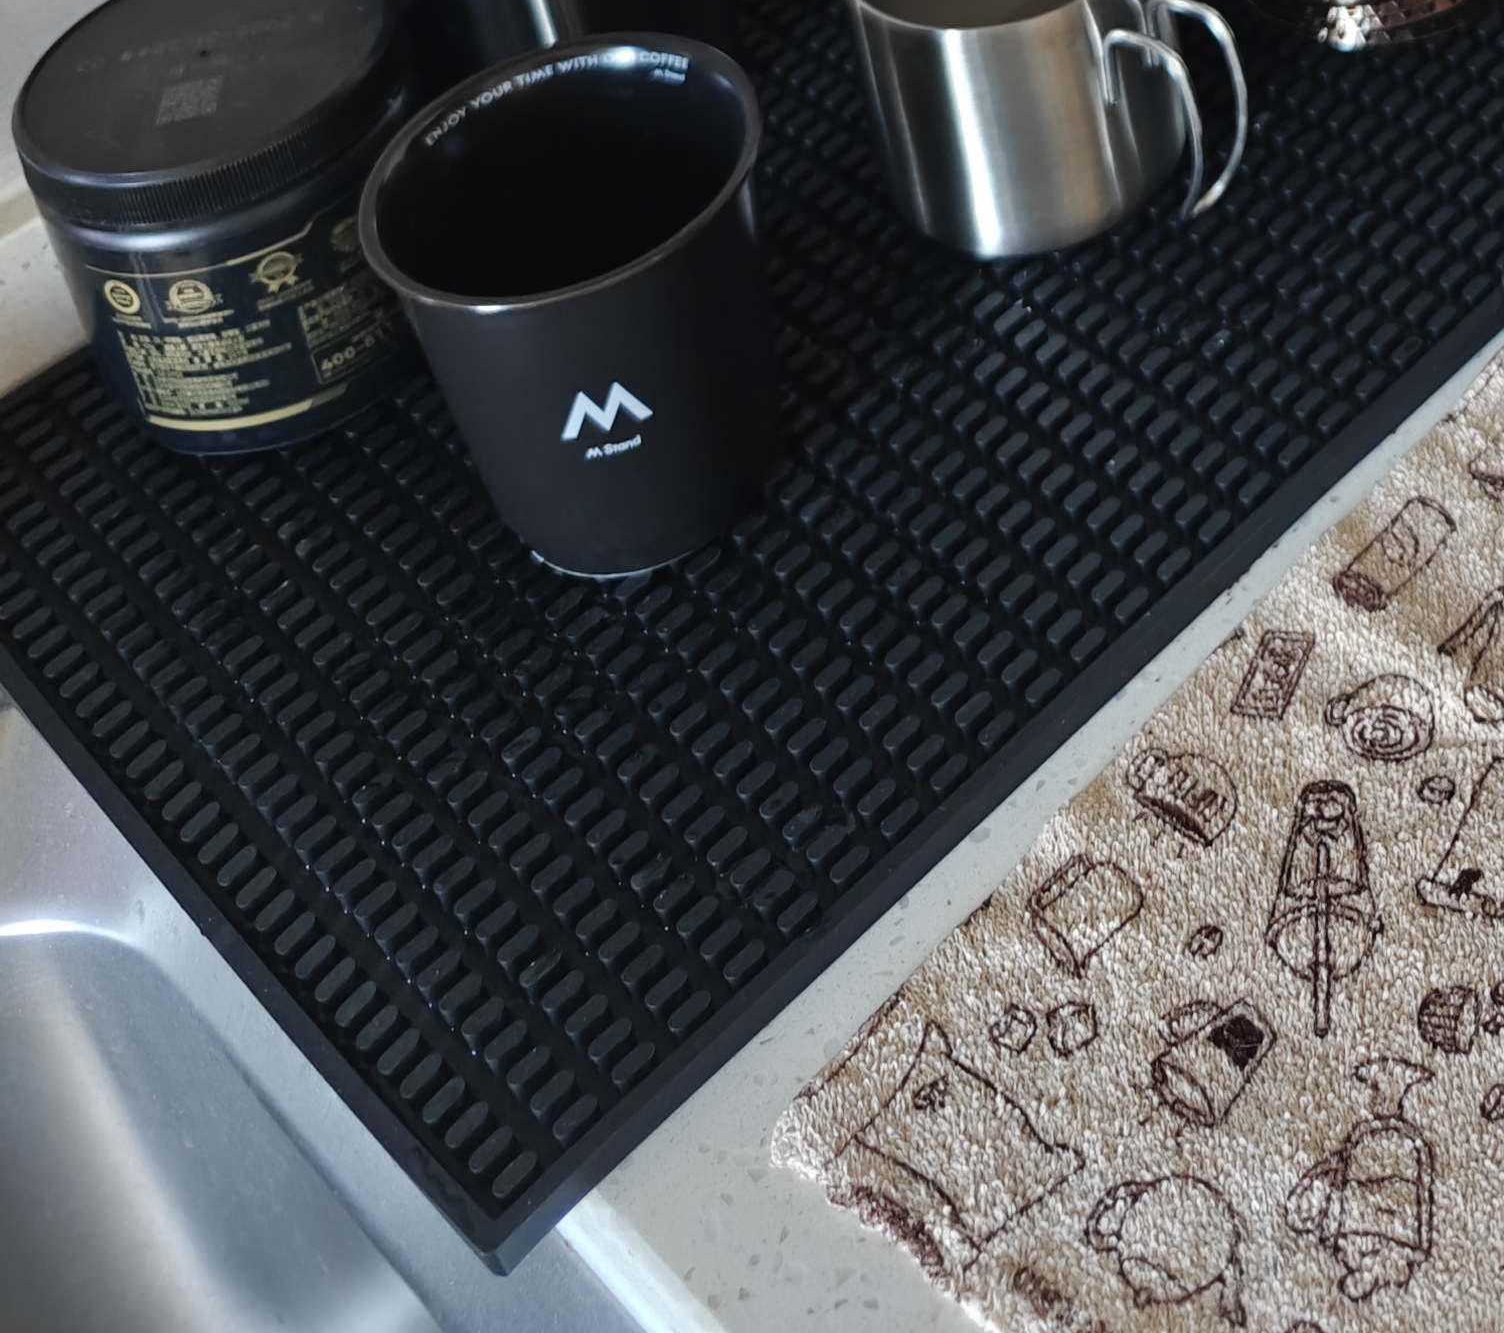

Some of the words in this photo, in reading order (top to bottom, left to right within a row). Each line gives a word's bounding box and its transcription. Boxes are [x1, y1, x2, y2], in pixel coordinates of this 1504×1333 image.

[424, 105, 467, 146] ENJOY
[469, 80, 513, 109] YOUR
[513, 64, 554, 87] TIME
[557, 53, 599, 73] WITH
[639, 50, 690, 70] COFFEE
[584, 446, 603, 460] M
[603, 433, 642, 456] Stand
